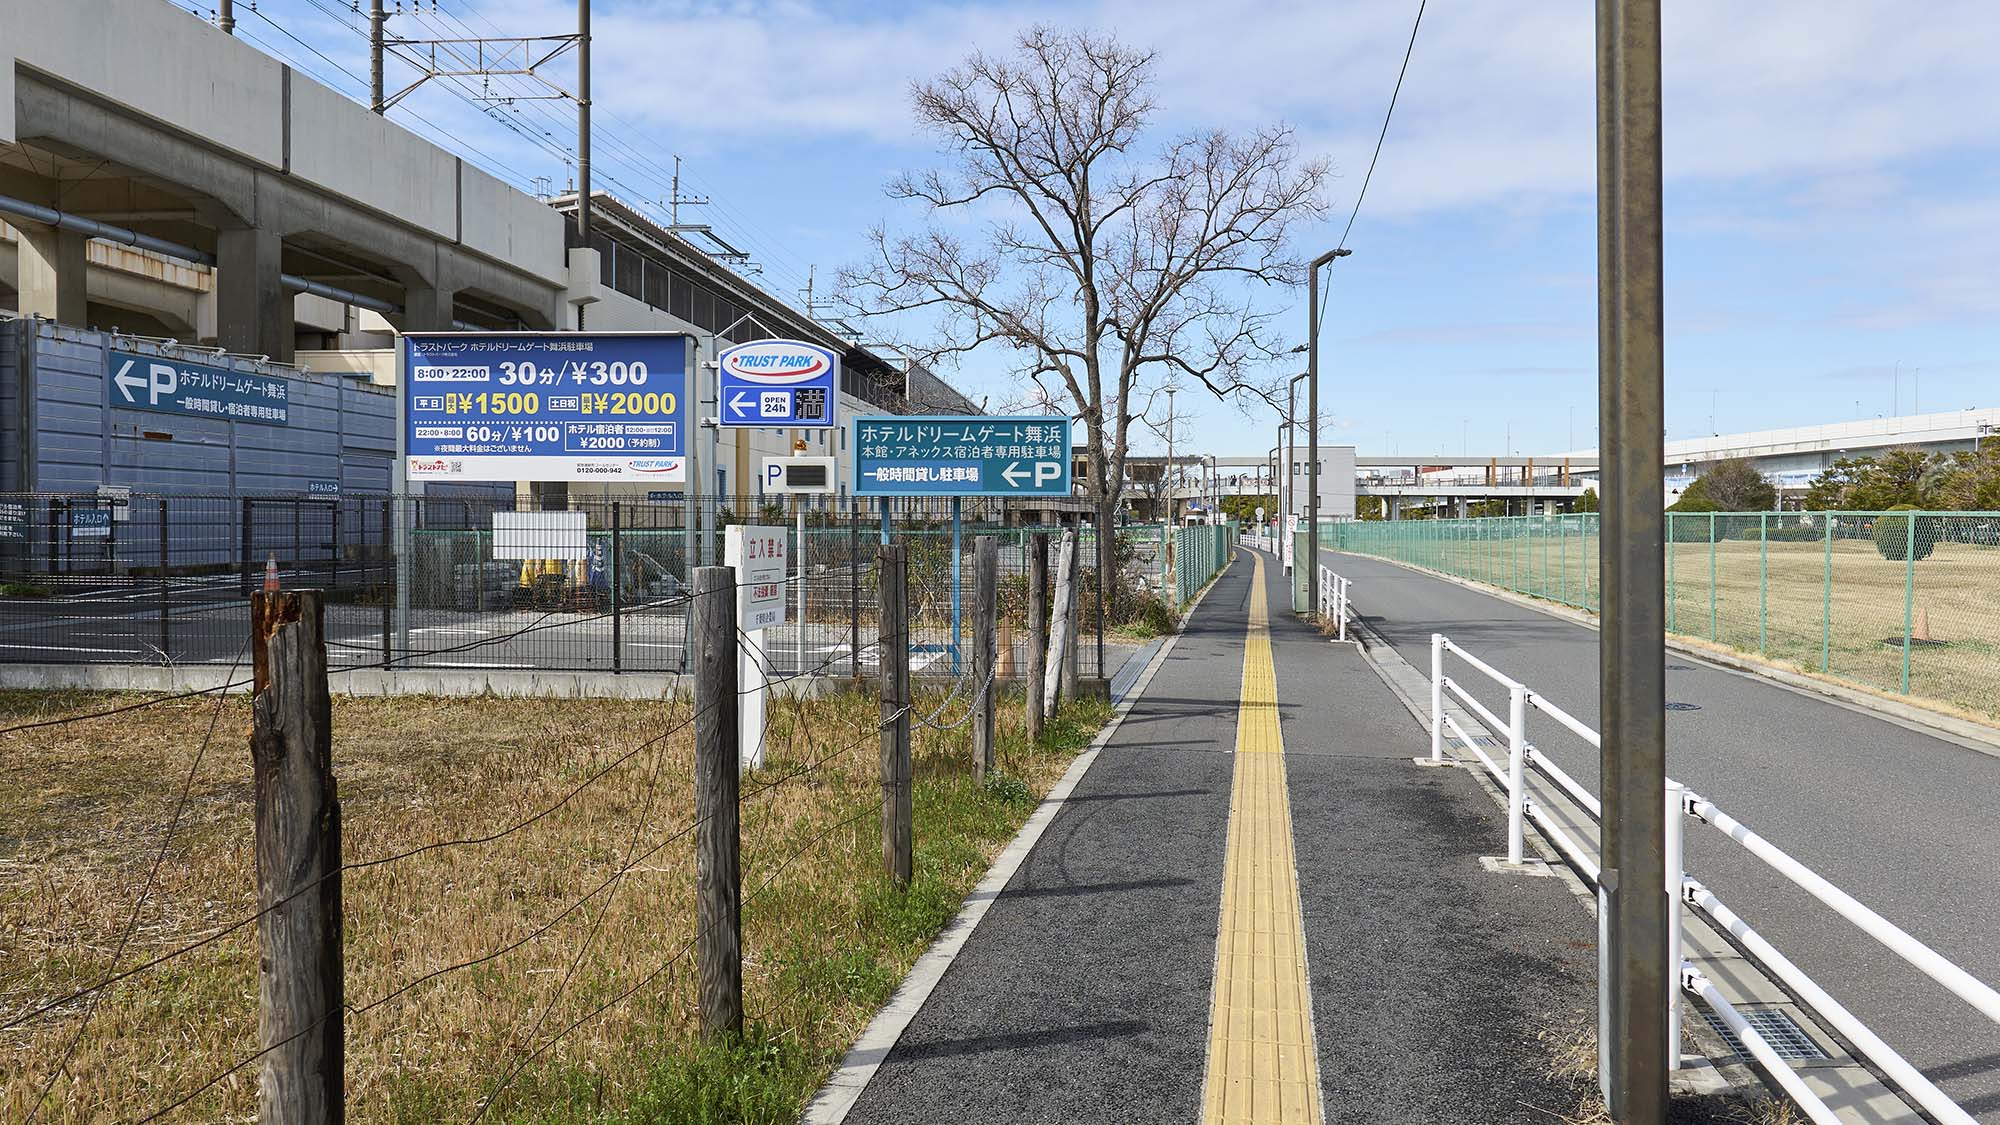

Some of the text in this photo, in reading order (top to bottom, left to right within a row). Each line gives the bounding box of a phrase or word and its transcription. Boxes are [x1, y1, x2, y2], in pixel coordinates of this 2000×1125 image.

[413, 341, 594, 352] トラストパーク ホテルドリームゲート舞浜駐車場
[739, 355, 813, 368] TRUST PARK
[417, 369, 444, 379] 8:00
[452, 369, 487, 379] 22:00
[149, 363, 178, 405] P
[180, 369, 286, 400] ホテルドリームゲート舞浜
[176, 396, 287, 421] 一般時間貸し・宿泊者専用駐車場
[419, 399, 439, 408] 平日
[458, 392, 540, 415] ¥1500
[551, 399, 576, 408] 土日祝
[594, 392, 677, 415] ¥2000
[764, 404, 786, 413] 24h
[417, 429, 440, 437] 22:00
[444, 429, 461, 437] 8:00
[568, 424, 625, 435] ホテル宿泊者
[861, 425, 1062, 444] ホテルドリームゲート舞浜
[580, 437, 625, 449] ¥2000
[861, 445, 1062, 459] 本館・アネックス宿泊者専用駐車場
[632, 460, 673, 468] TRUST PARK
[767, 464, 782, 486] P
[863, 466, 979, 482] 一般時間貸し駐車場
[1035, 461, 1062, 488] P
[749, 538, 783, 559] 立入禁止
